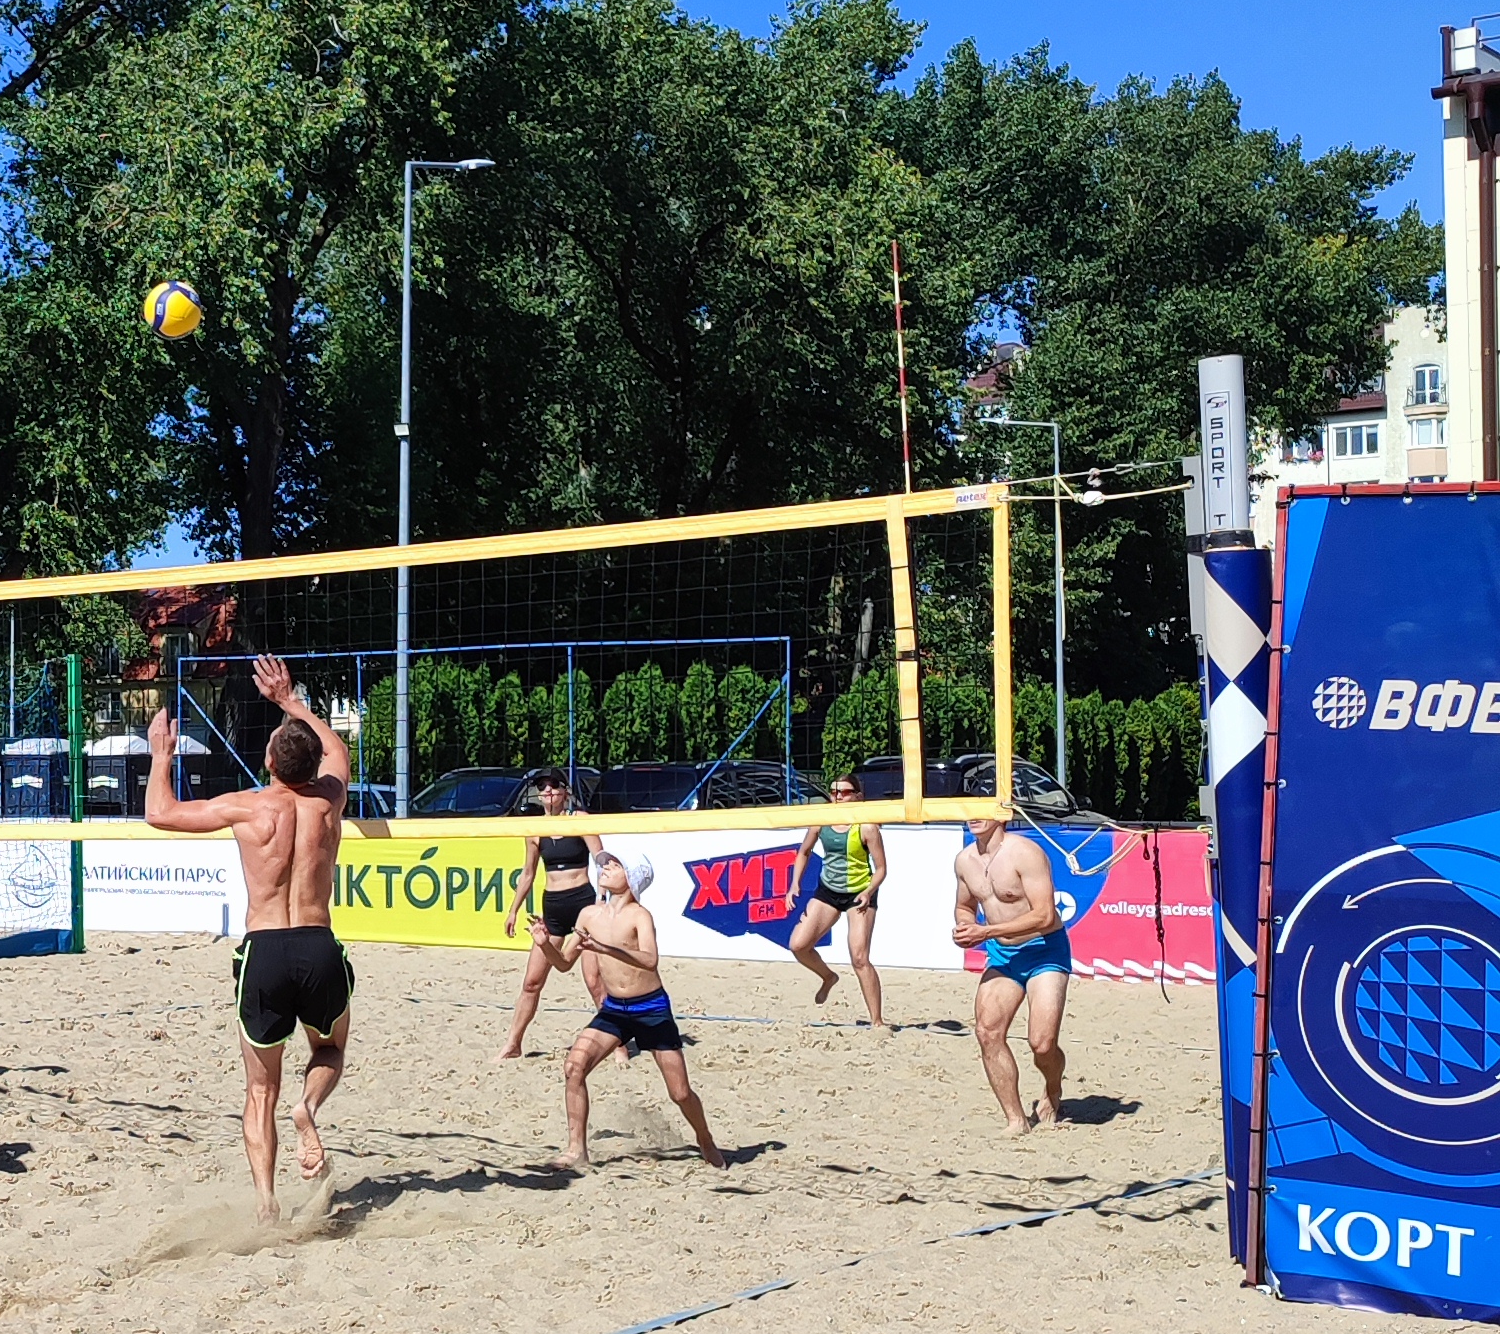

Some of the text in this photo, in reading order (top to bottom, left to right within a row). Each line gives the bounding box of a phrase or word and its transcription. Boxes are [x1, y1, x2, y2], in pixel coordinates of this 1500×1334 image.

[1211, 416, 1225, 489] SPORT
[82, 863, 227, 883] АЛТИЙСКИЙ ПАРУС
[691, 849, 798, 910] ХИТ
[1099, 901, 1213, 918] volleygadres
[1297, 1203, 1475, 1277] КОРТ
